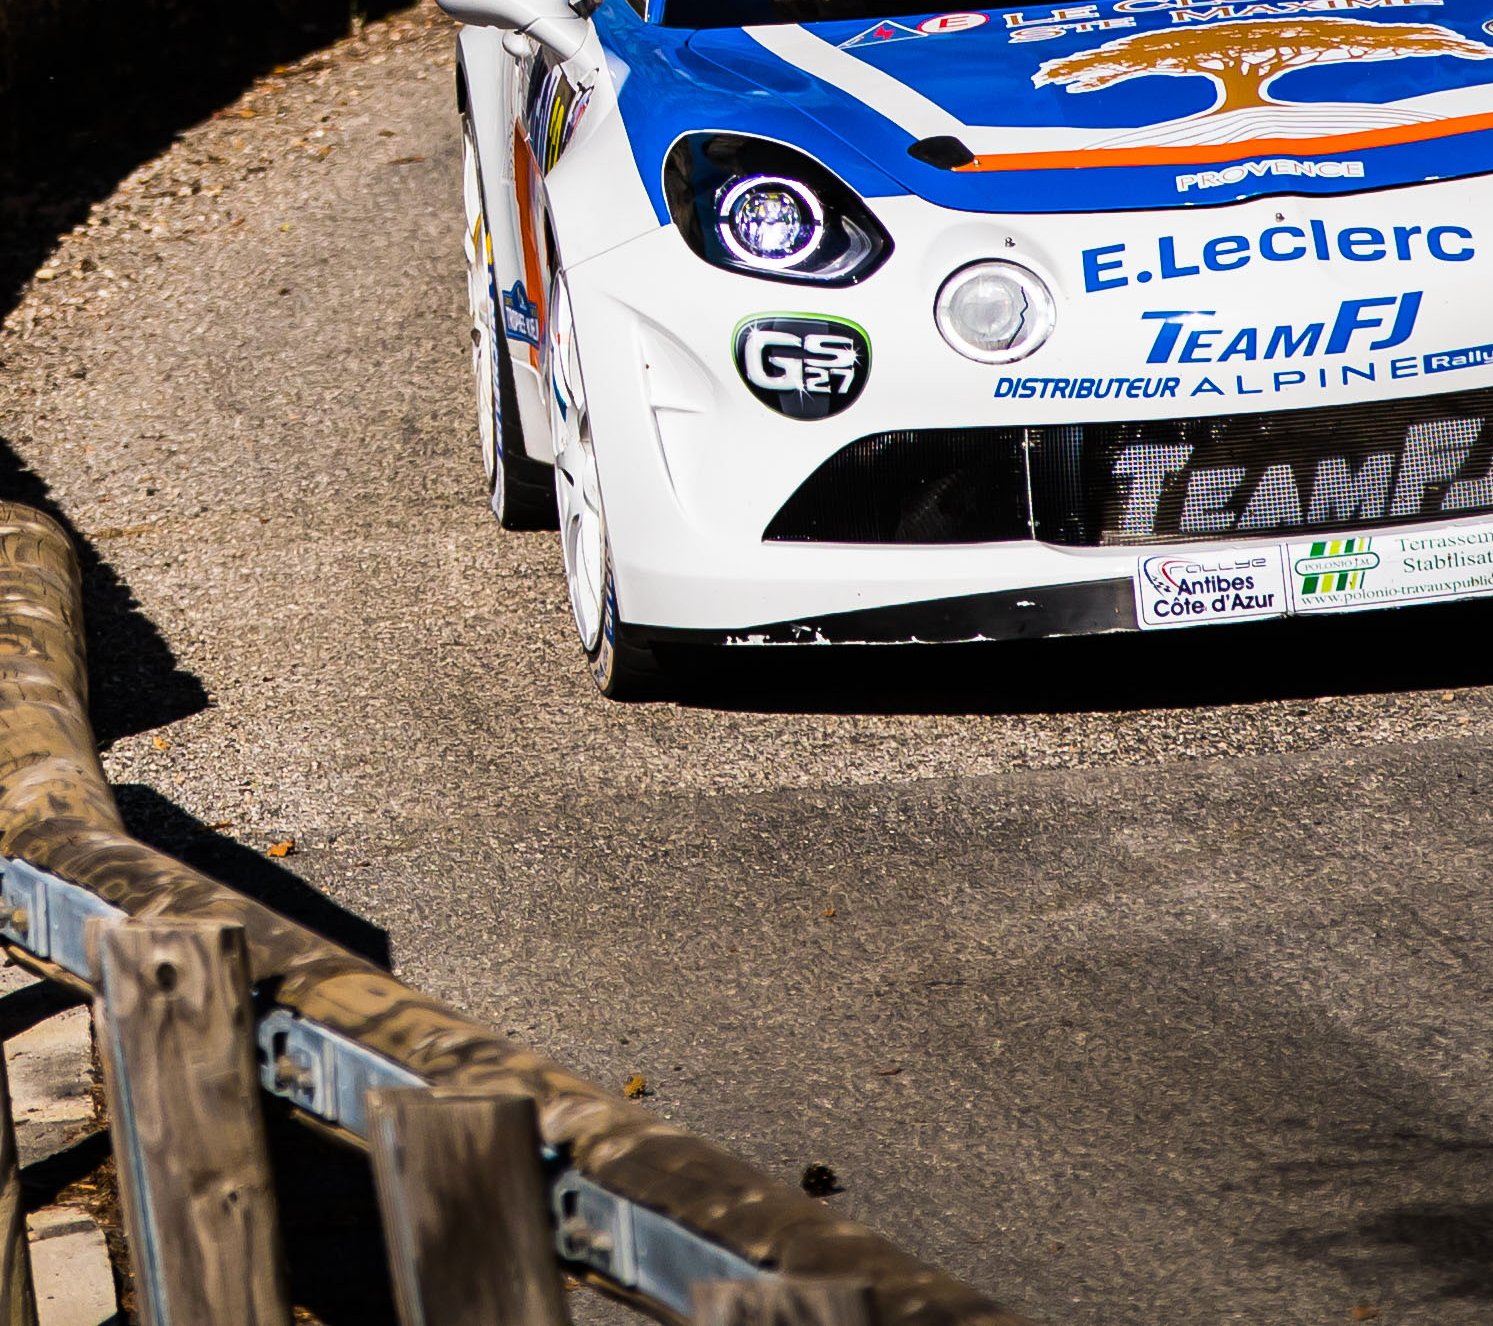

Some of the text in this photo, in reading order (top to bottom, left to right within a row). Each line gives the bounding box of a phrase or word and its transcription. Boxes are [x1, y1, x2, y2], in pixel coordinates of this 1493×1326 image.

[1003, 5, 1100, 28] LE
[1176, 160, 1365, 192] PROVENCE
[1082, 219, 1476, 293] E.Leclerc
[994, 357, 1419, 399] DISTRIBUTEUR ALPINE
[1305, 561, 1353, 571] POLONIO
[1178, 575, 1255, 596] Antibes
[1153, 593, 1275, 617] Côte d'Azur
